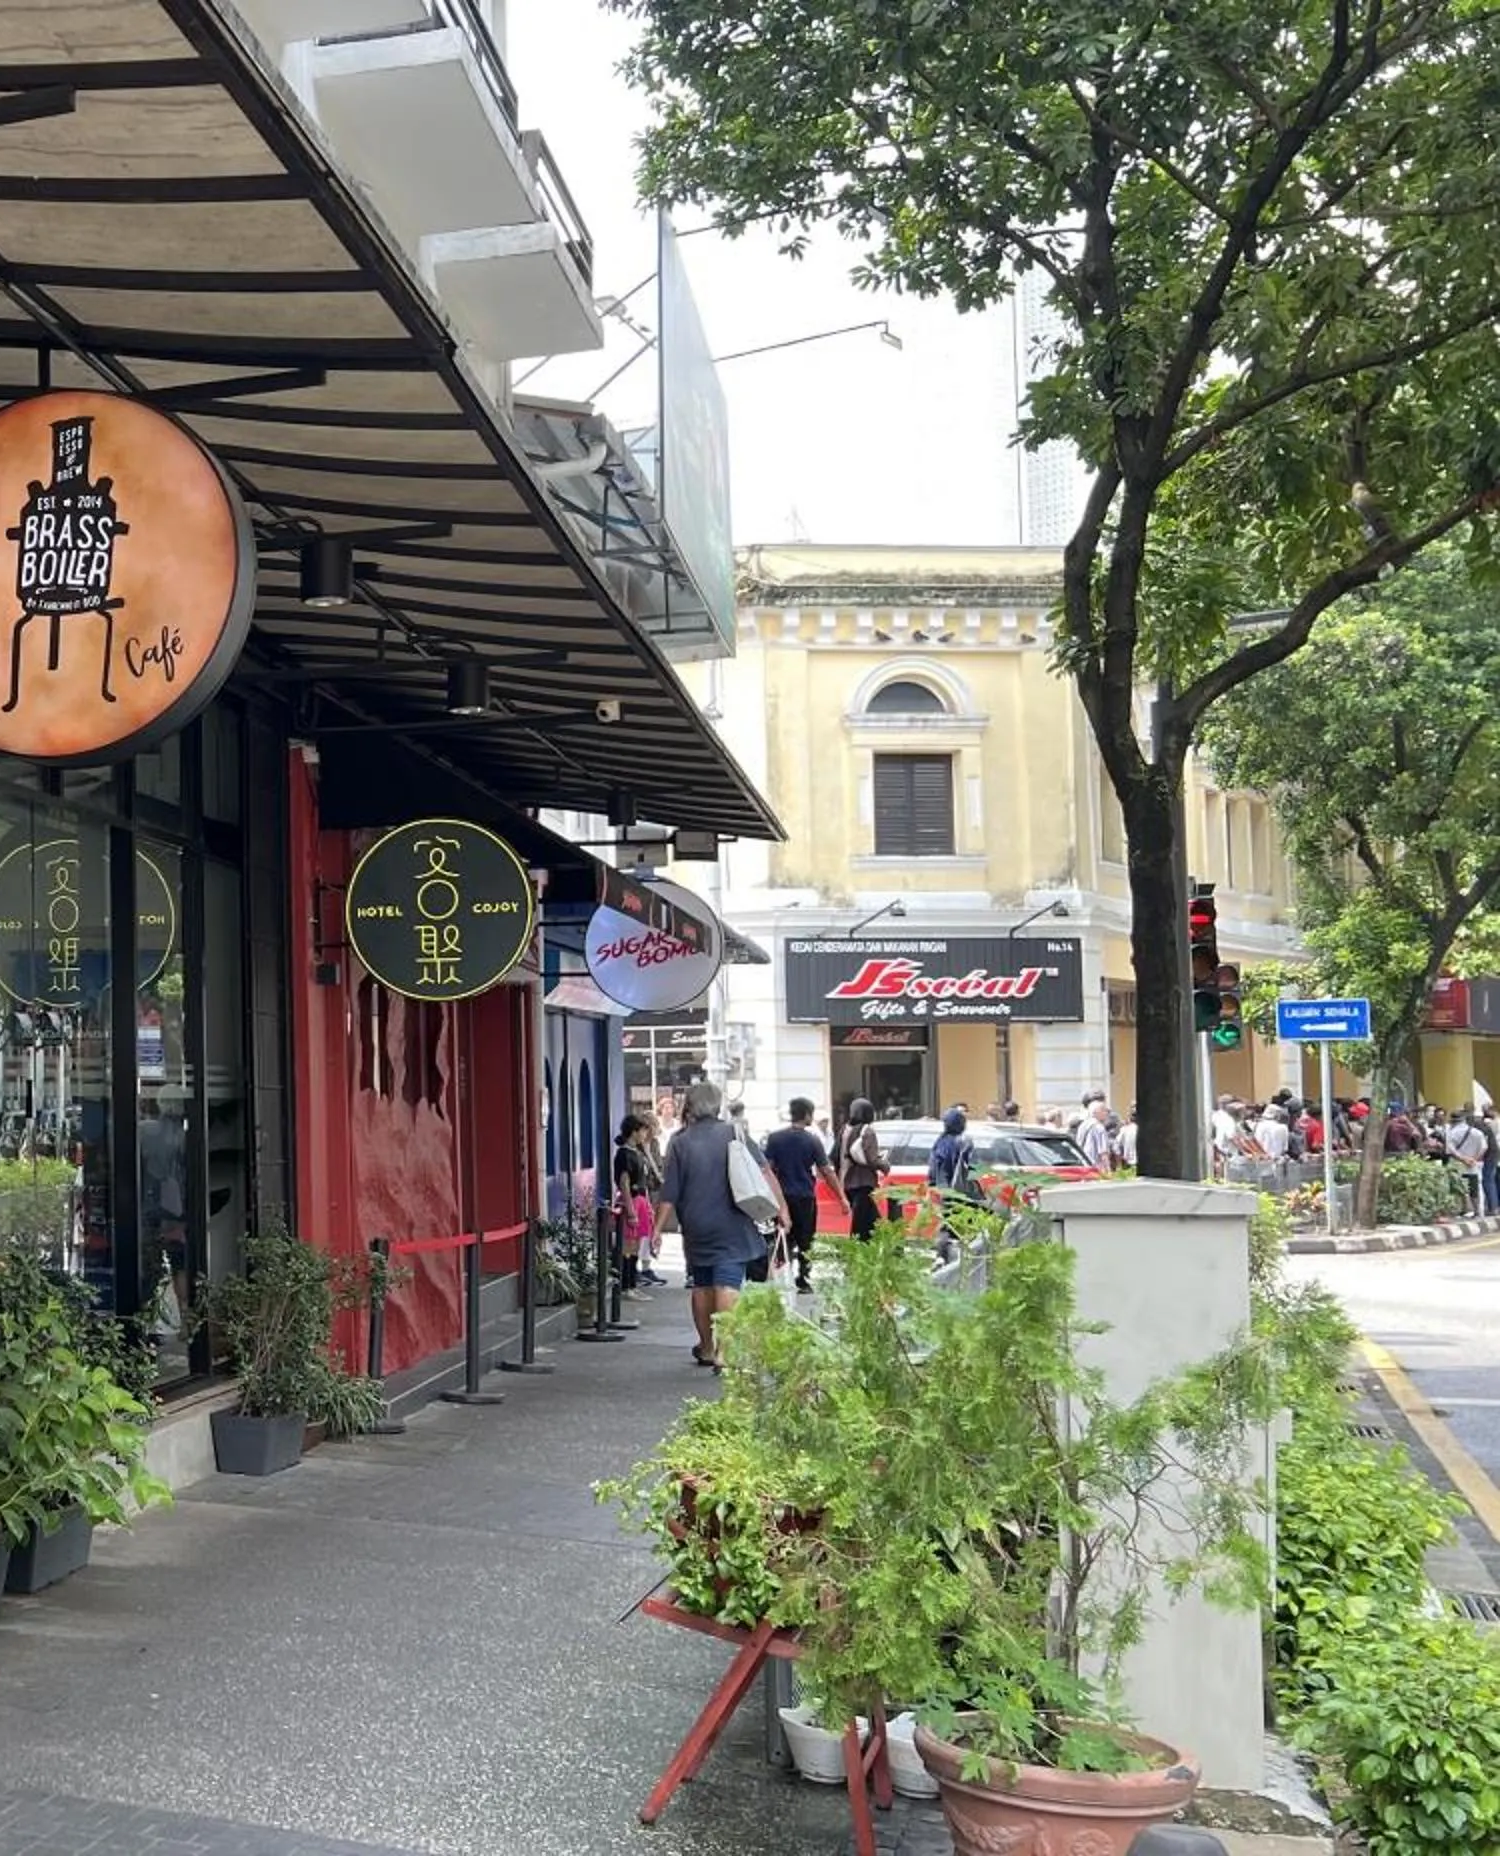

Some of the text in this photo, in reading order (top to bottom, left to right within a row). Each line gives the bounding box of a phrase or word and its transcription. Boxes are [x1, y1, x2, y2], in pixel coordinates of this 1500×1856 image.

[24, 513, 113, 550] BRASS
[22, 549, 109, 587] BOILER
[125, 625, 184, 682] Café
[357, 902, 519, 918] HOTEL COJOY
[860, 1000, 906, 1020] Gifts
[913, 1000, 928, 1015] &
